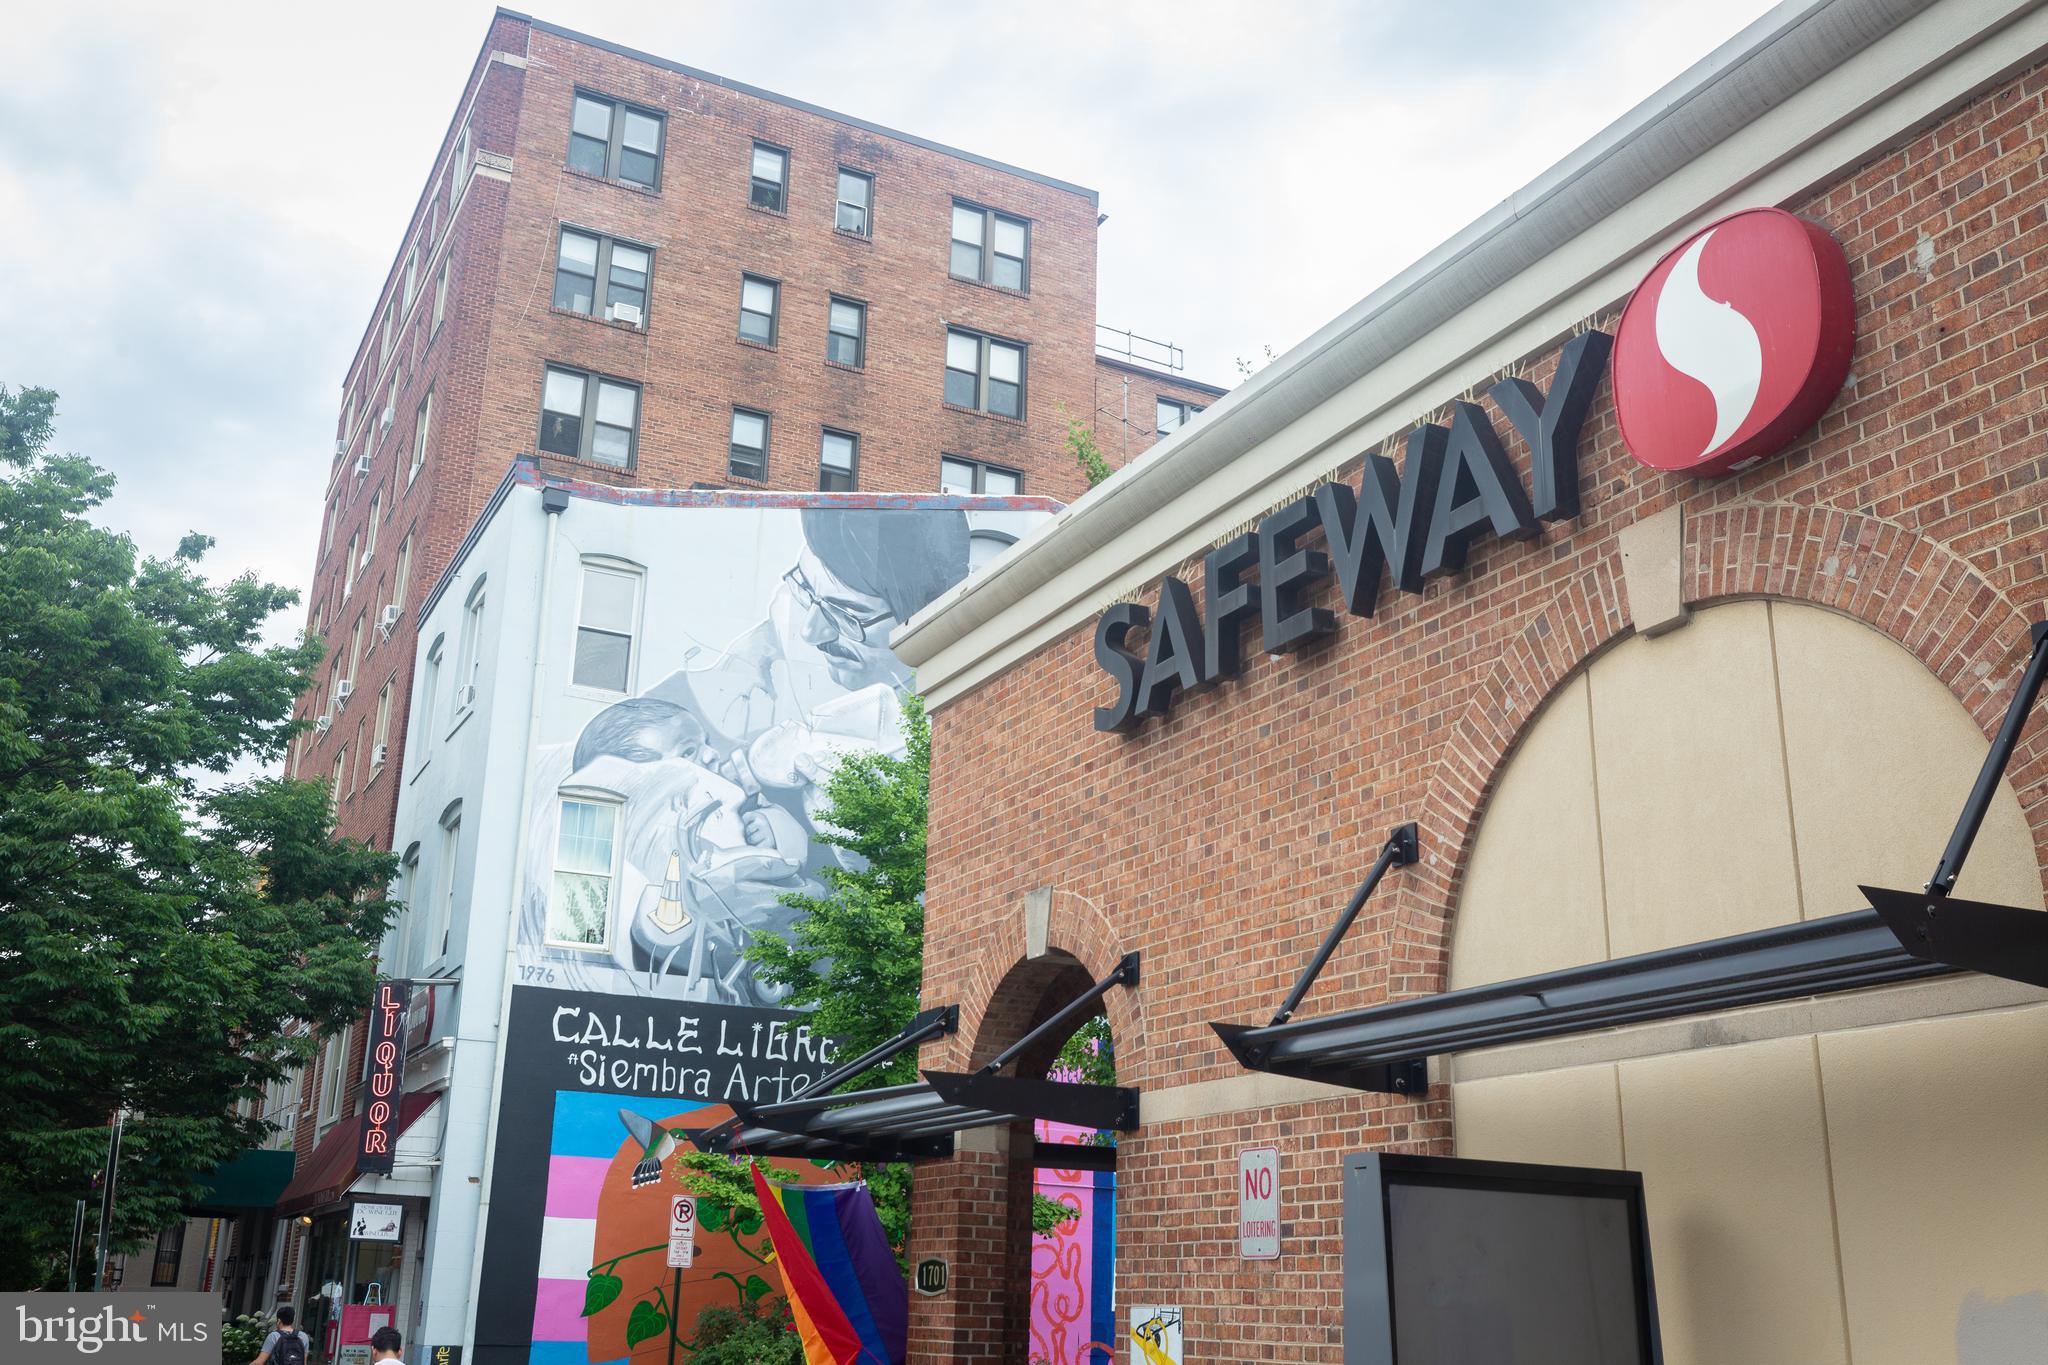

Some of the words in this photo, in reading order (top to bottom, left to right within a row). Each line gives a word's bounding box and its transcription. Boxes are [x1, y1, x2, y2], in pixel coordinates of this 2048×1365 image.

[1094, 329, 1613, 732] SAFEWAY
[518, 965, 555, 983] 1976
[552, 1006, 703, 1054] CALLE
[366, 986, 400, 1153] LIQUOR
[579, 1050, 711, 1097] Siembra
[723, 1062, 810, 1104] Arte
[1245, 1167, 1272, 1200] NO
[1242, 1220, 1276, 1238] LOITERING
[922, 1264, 945, 1286] 1701
